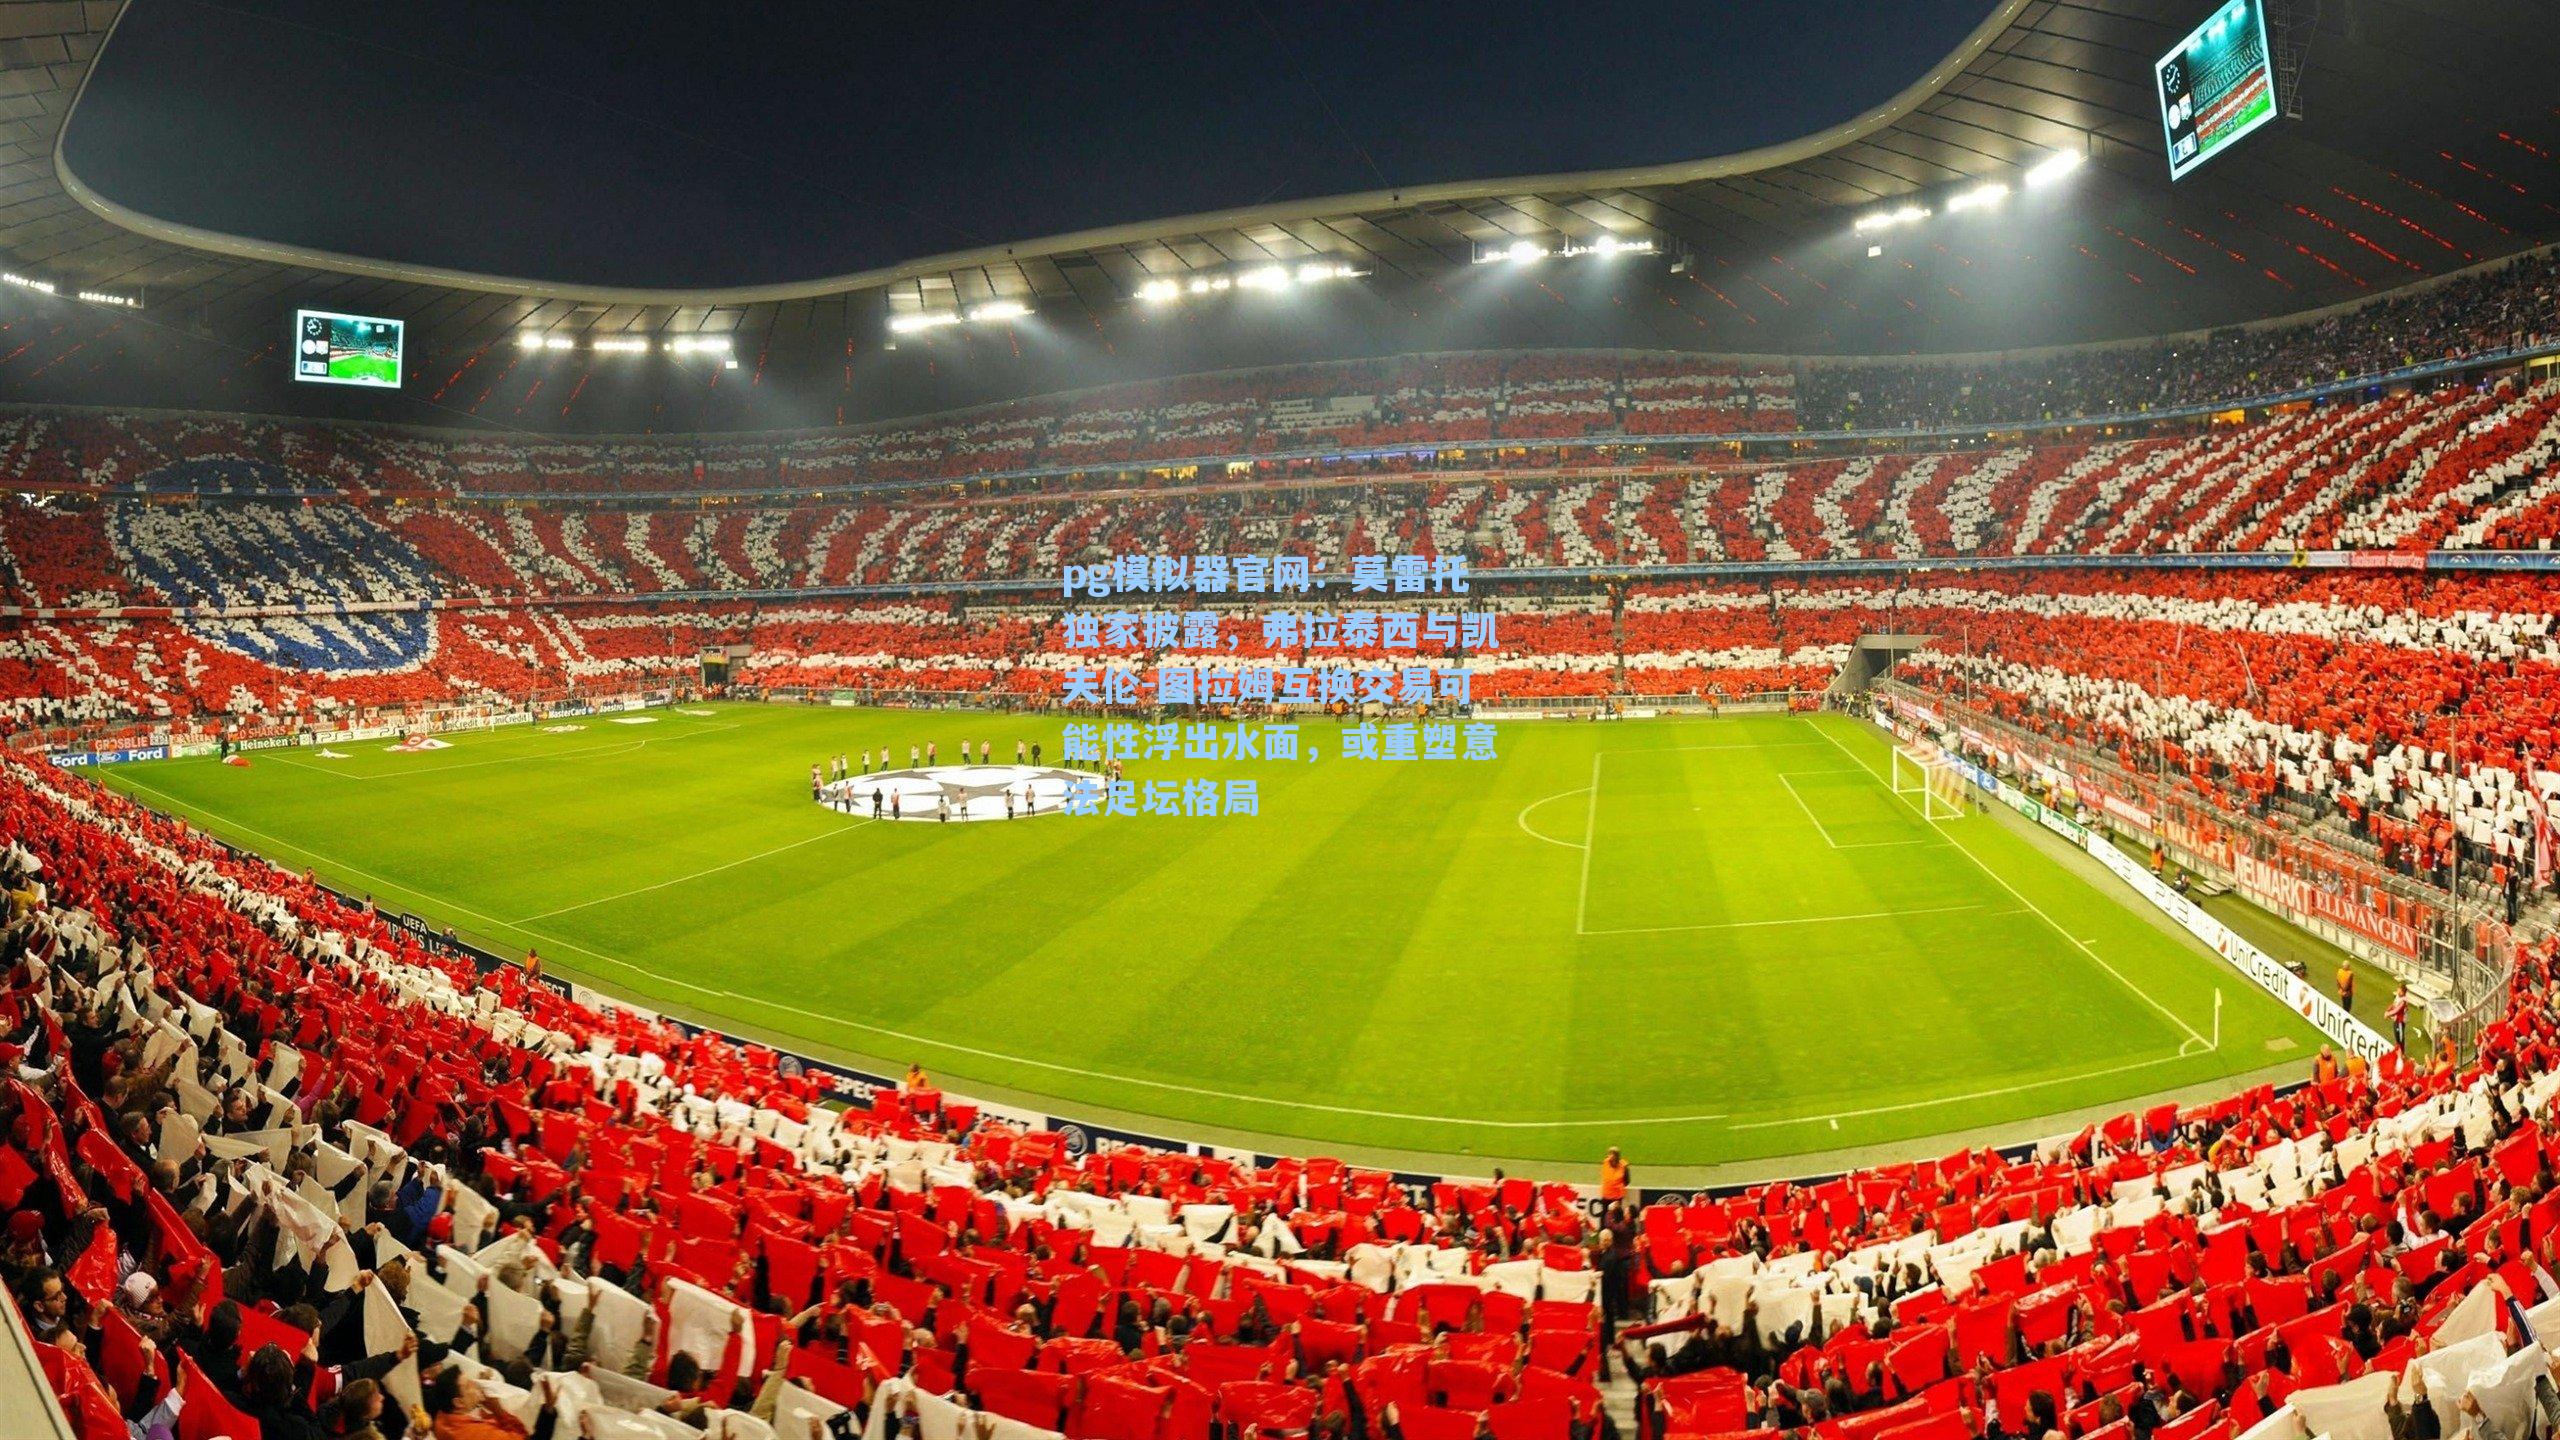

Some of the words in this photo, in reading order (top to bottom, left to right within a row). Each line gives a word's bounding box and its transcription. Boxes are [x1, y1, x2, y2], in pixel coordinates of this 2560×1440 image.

[128, 748, 163, 761] Ford
[240, 738, 289, 751] Heineken
[52, 756, 88, 768] Ford
[403, 915, 427, 935] UEFA
[2316, 889, 2415, 951] ELLWANGEN
[2229, 936, 2290, 1001] UniCredit
[2316, 997, 2392, 1064] UniCredi
